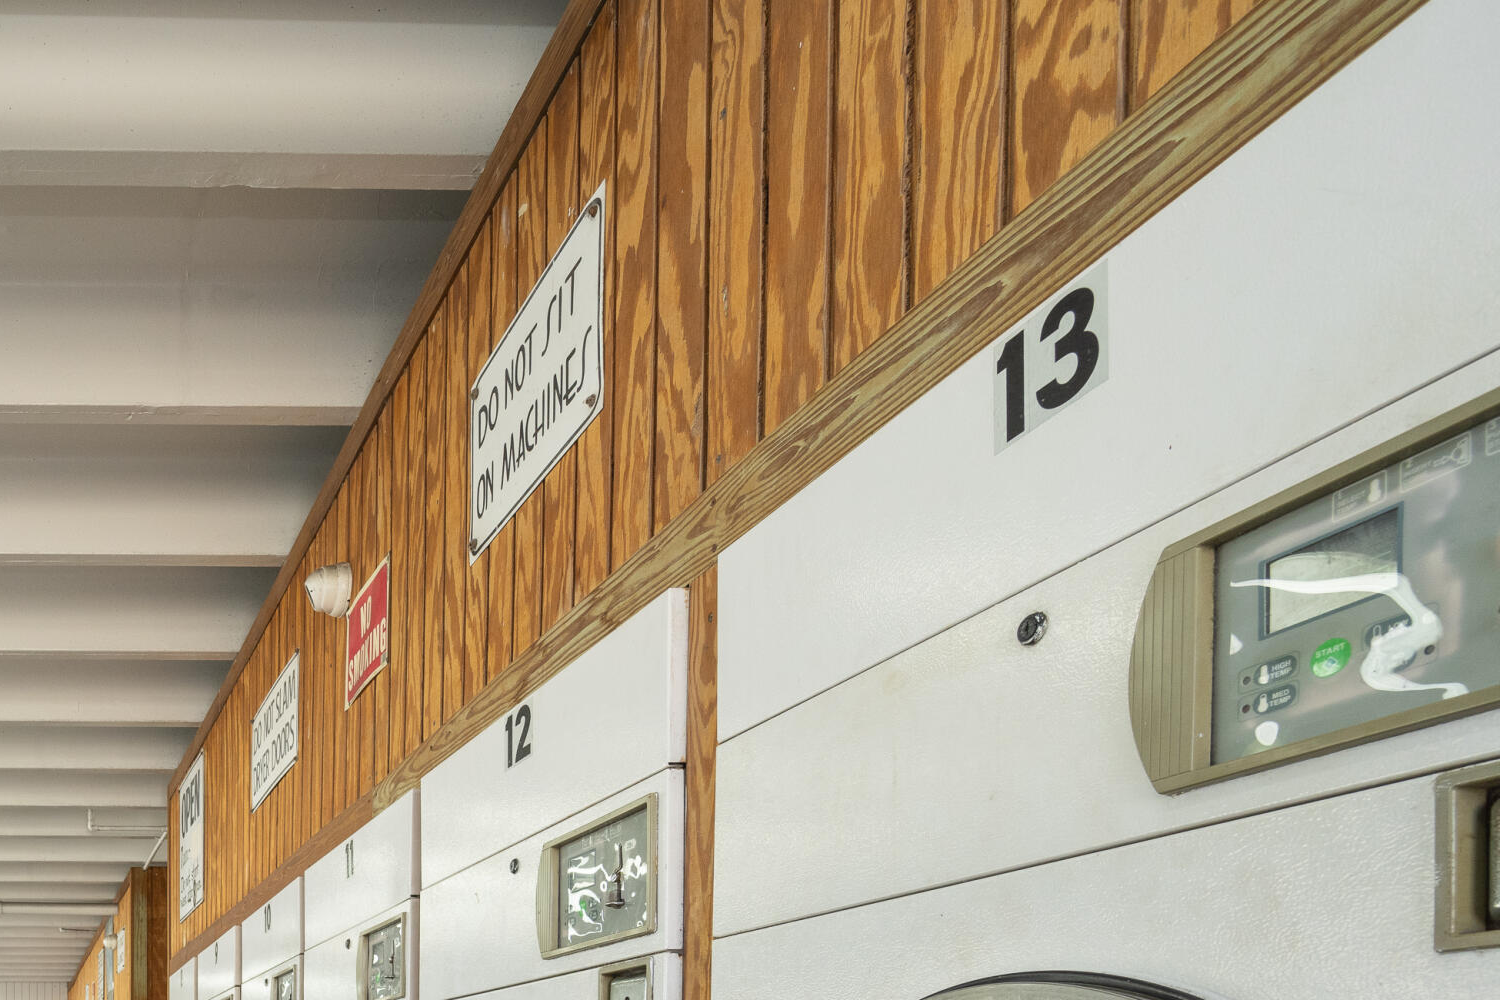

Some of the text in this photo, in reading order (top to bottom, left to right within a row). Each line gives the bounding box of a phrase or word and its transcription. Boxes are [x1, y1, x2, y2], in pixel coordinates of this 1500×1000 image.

[477, 257, 582, 449] DO NOT SIT
[996, 287, 1100, 443] 13
[476, 325, 592, 519] ON MACHINES
[360, 595, 372, 639] NO
[348, 617, 387, 692] SMOKING
[1269, 667, 1292, 679] TEMP
[1271, 659, 1292, 671] HIGH
[1315, 642, 1346, 658] START
[253, 669, 296, 756] DO NOT SLAM
[1269, 695, 1292, 708] TEMP
[1272, 688, 1290, 700] MED
[253, 714, 295, 797] DRYER DOORS
[505, 704, 532, 769] 12
[181, 769, 200, 839] OPEN
[344, 840, 354, 879] 11
[264, 903, 271, 933] 10
